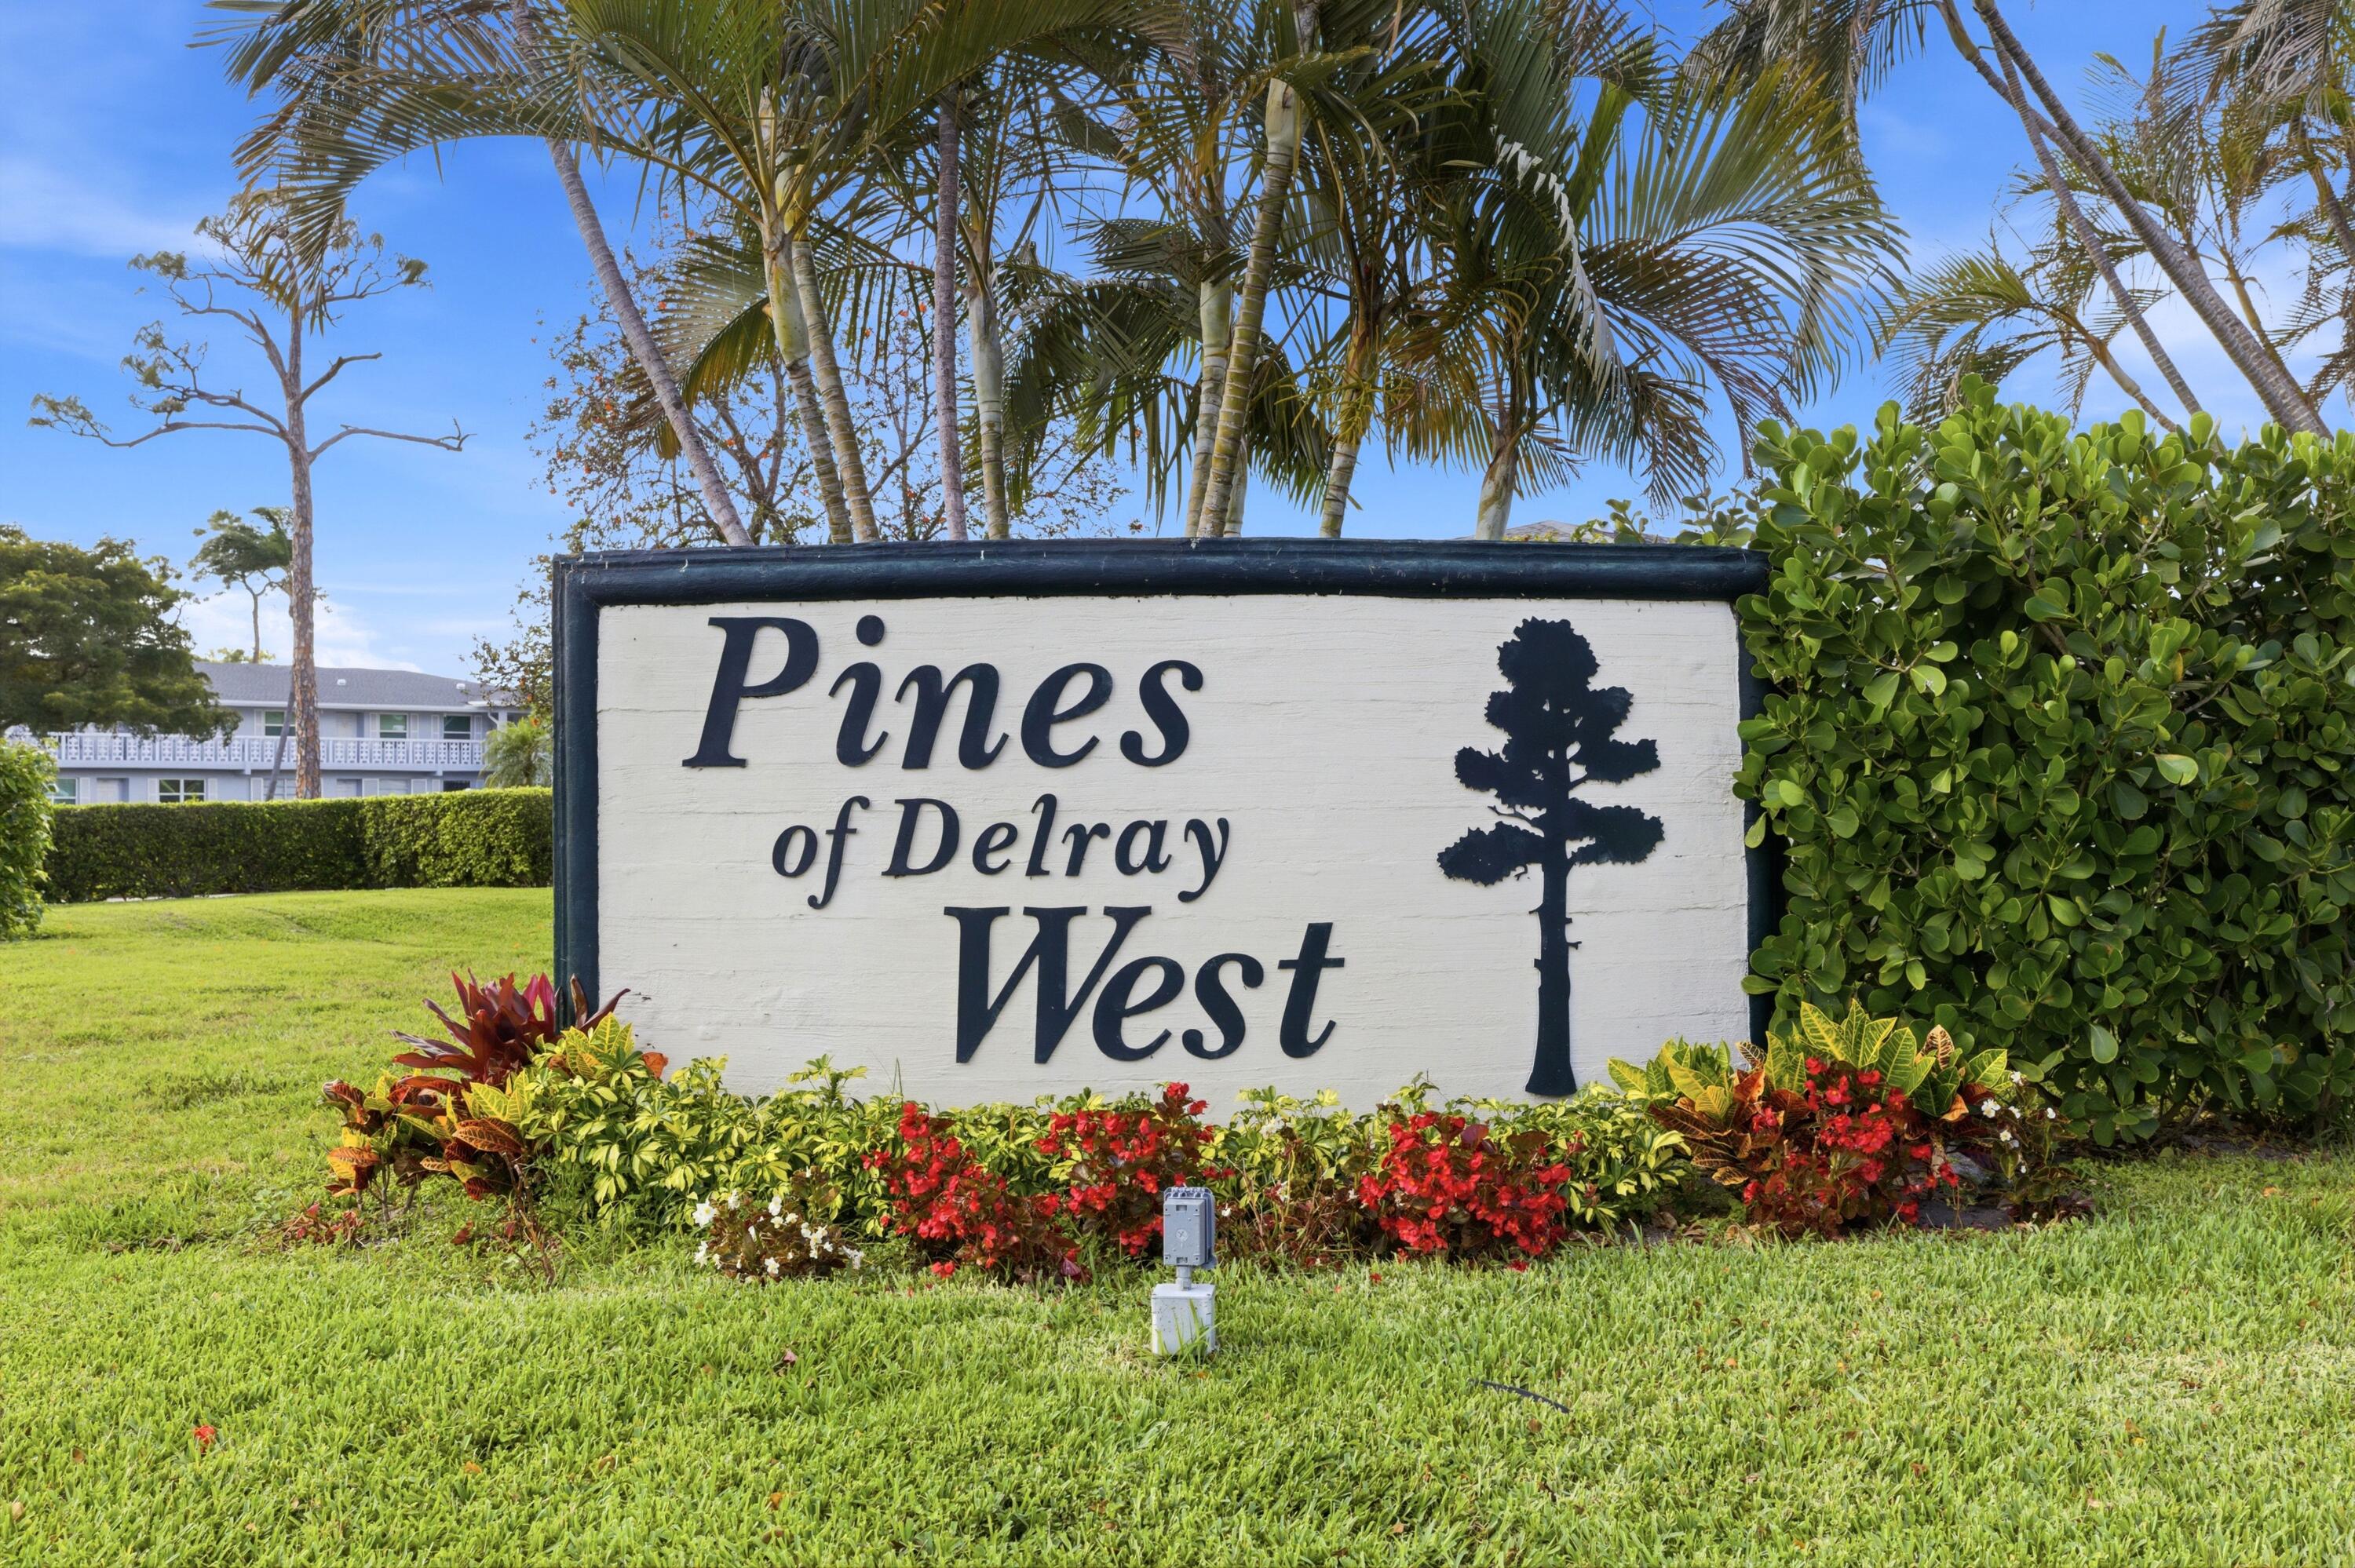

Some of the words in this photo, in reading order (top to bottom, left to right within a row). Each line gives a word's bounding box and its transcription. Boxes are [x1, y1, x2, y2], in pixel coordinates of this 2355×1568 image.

[682, 615, 1203, 770] Pines
[772, 796, 870, 910] of
[882, 794, 1229, 903] Delray
[944, 906, 1345, 1064] West
